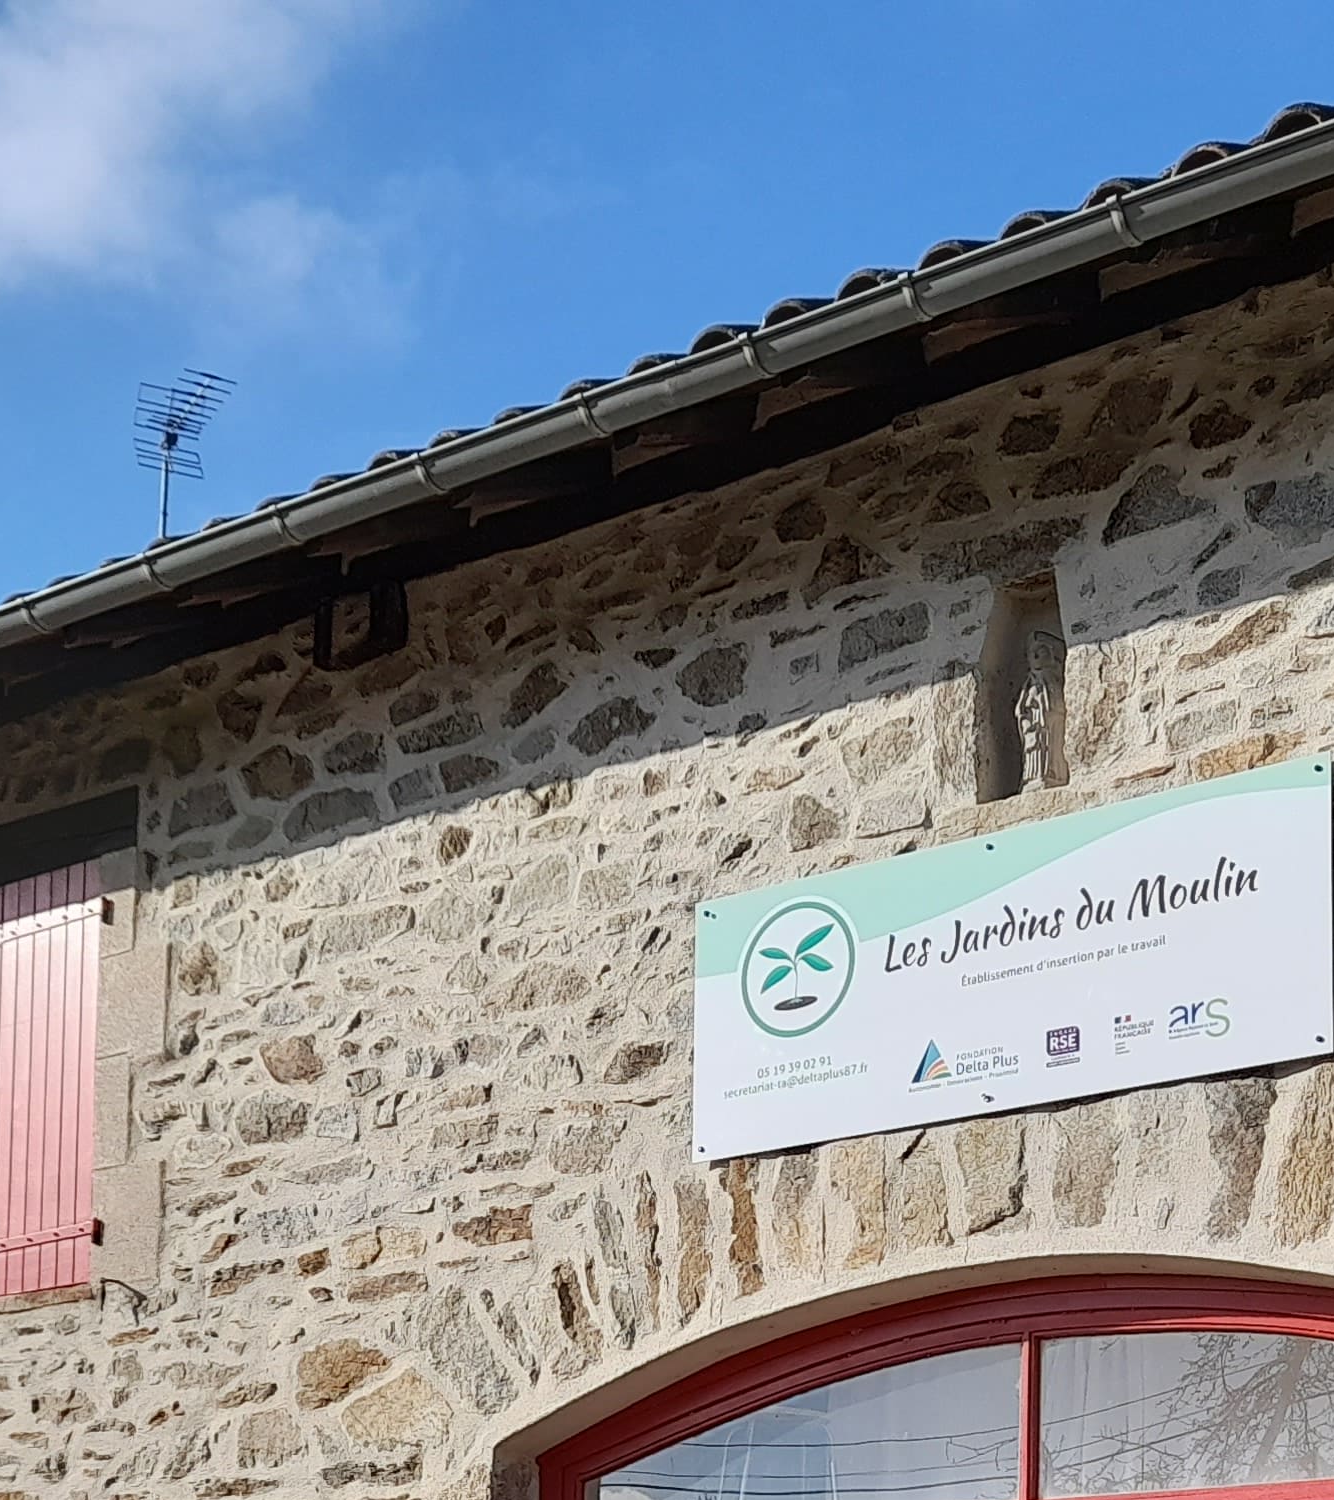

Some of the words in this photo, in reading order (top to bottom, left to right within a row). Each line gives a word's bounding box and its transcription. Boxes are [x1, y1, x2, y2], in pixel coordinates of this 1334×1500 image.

[884, 934, 932, 973] Les
[940, 904, 1065, 964] Jardins
[1075, 887, 1115, 931] du
[1127, 856, 1259, 921] Moulin
[961, 963, 1034, 987] Établissement
[1036, 950, 1094, 971] d'insertion
[1097, 946, 1114, 962] par
[1117, 943, 1128, 955] le
[1131, 935, 1166, 952] travail
[1050, 1033, 1077, 1051] RSE
[956, 1046, 1004, 1061] FONDATION
[757, 1066, 770, 1079] 05
[773, 1063, 786, 1076] 19
[788, 1060, 801, 1073] 39
[803, 1058, 816, 1070] 02
[819, 1056, 832, 1067] 91
[956, 1060, 989, 1075] Delta
[993, 1055, 1019, 1069] Plus
